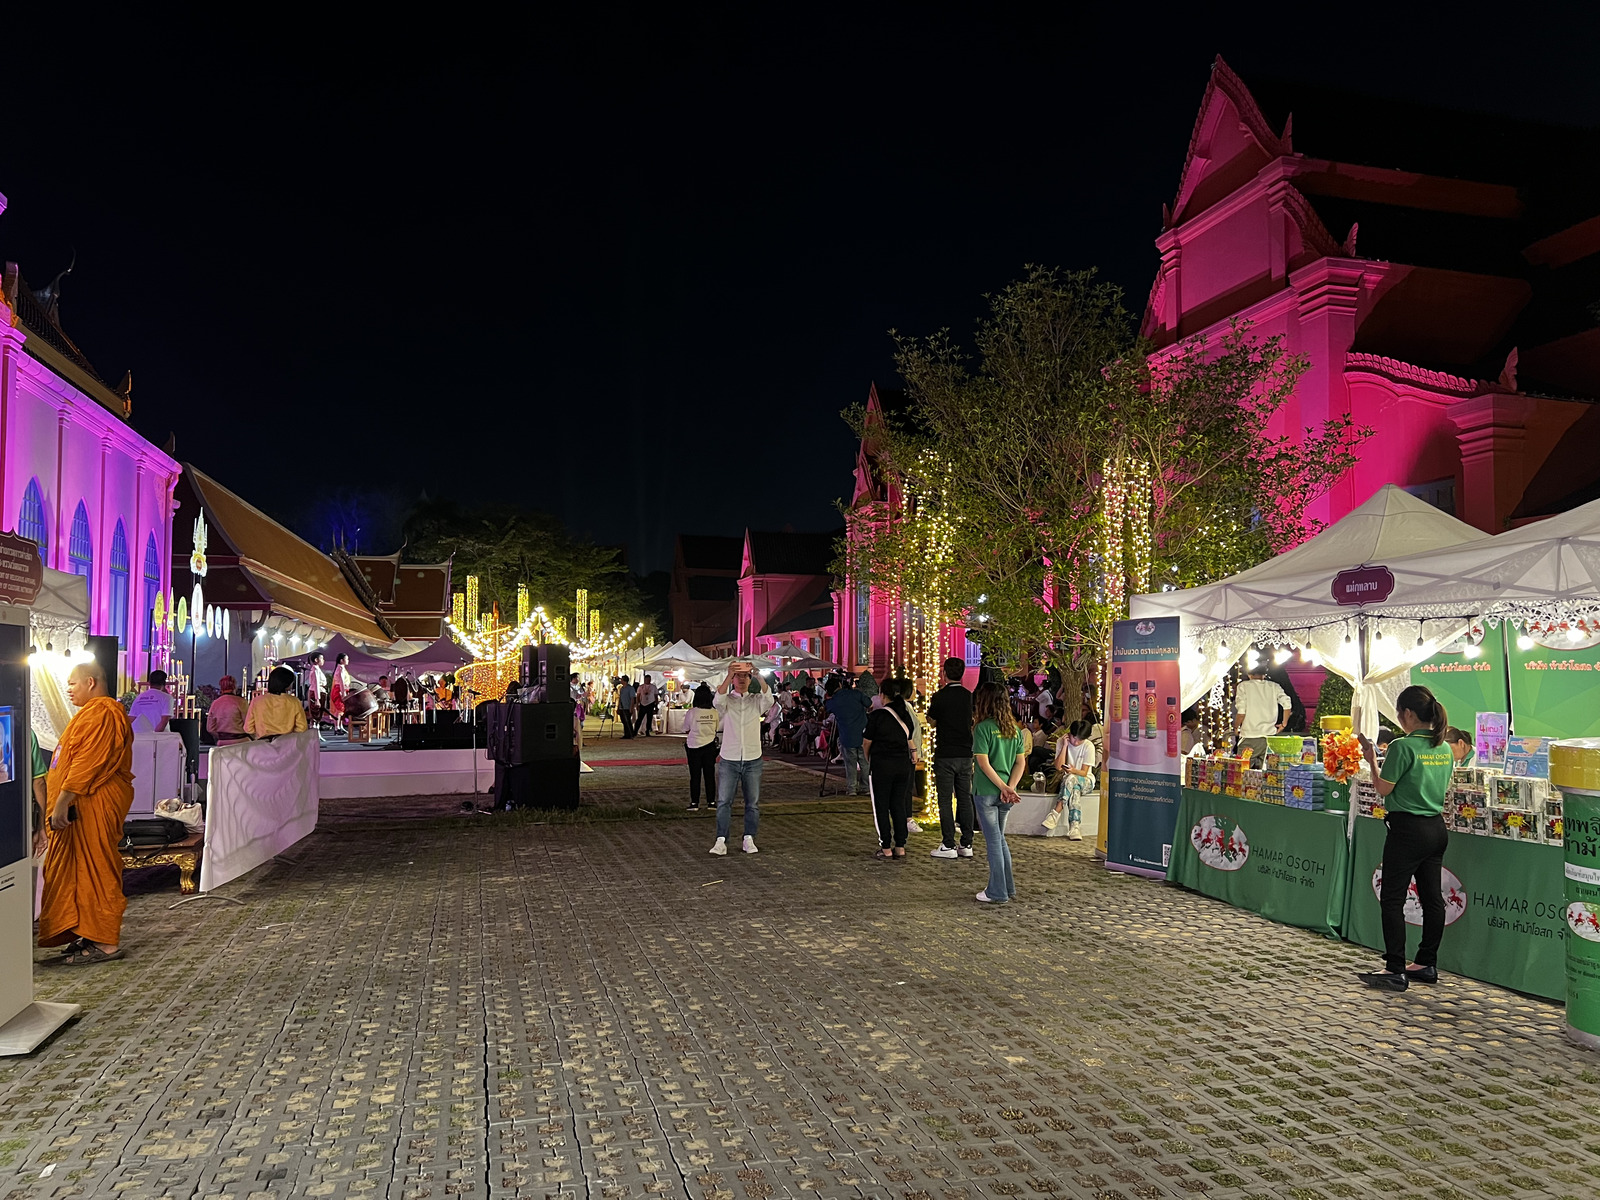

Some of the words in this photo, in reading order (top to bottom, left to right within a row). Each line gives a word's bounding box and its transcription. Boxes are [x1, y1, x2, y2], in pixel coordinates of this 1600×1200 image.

[1345, 580, 1378, 596] แม่กุหลาบ
[1252, 845, 1283, 864] HAMAR
[1286, 855, 1326, 876] OSOTH
[1473, 891, 1529, 915] HAMAR
[1534, 901, 1566, 922] OSO
[1487, 915, 1510, 930] บริษัท
[1512, 919, 1553, 939] ห้าม้าโอสถ
